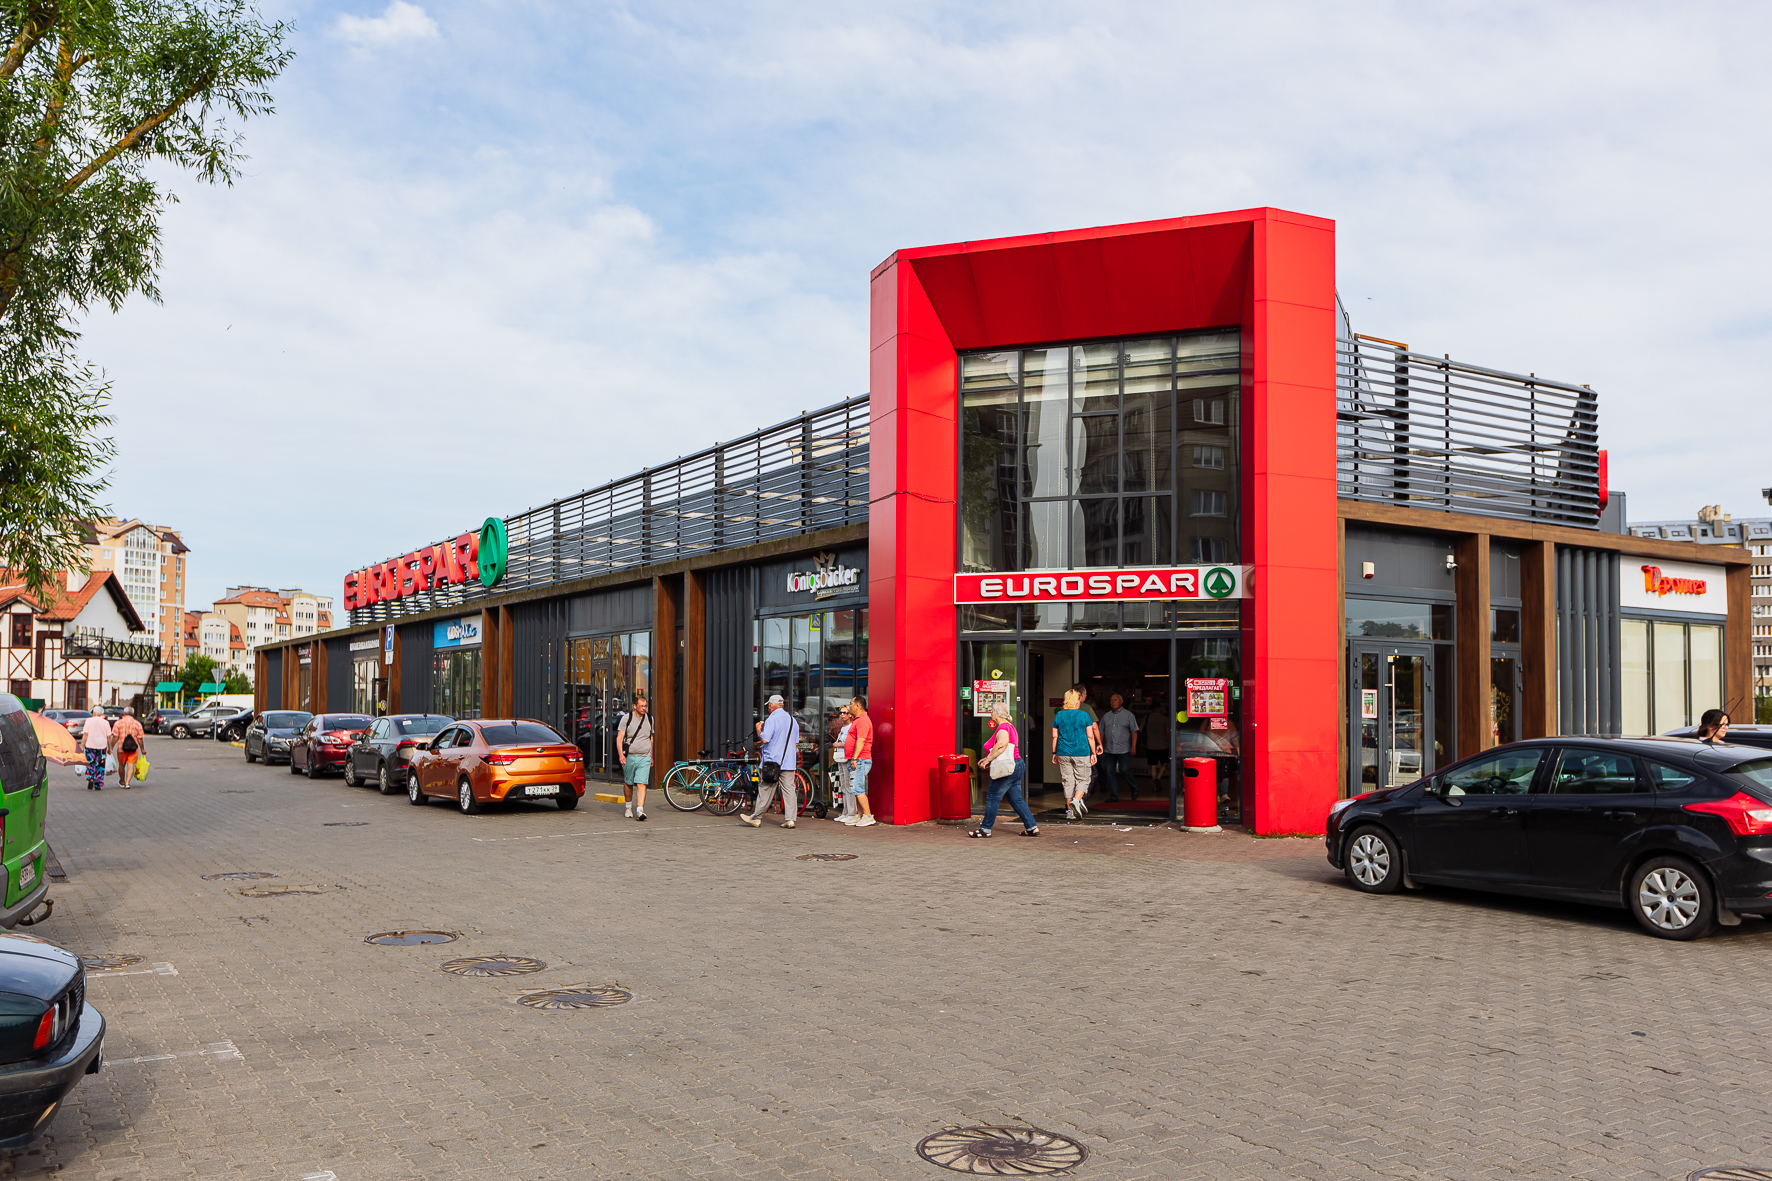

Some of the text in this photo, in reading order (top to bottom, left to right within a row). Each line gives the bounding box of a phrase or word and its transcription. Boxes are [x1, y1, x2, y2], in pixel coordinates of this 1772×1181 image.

[344, 533, 479, 611] EUROSPAR
[980, 573, 1195, 598] EUROSPAR
[386, 628, 392, 648] P
